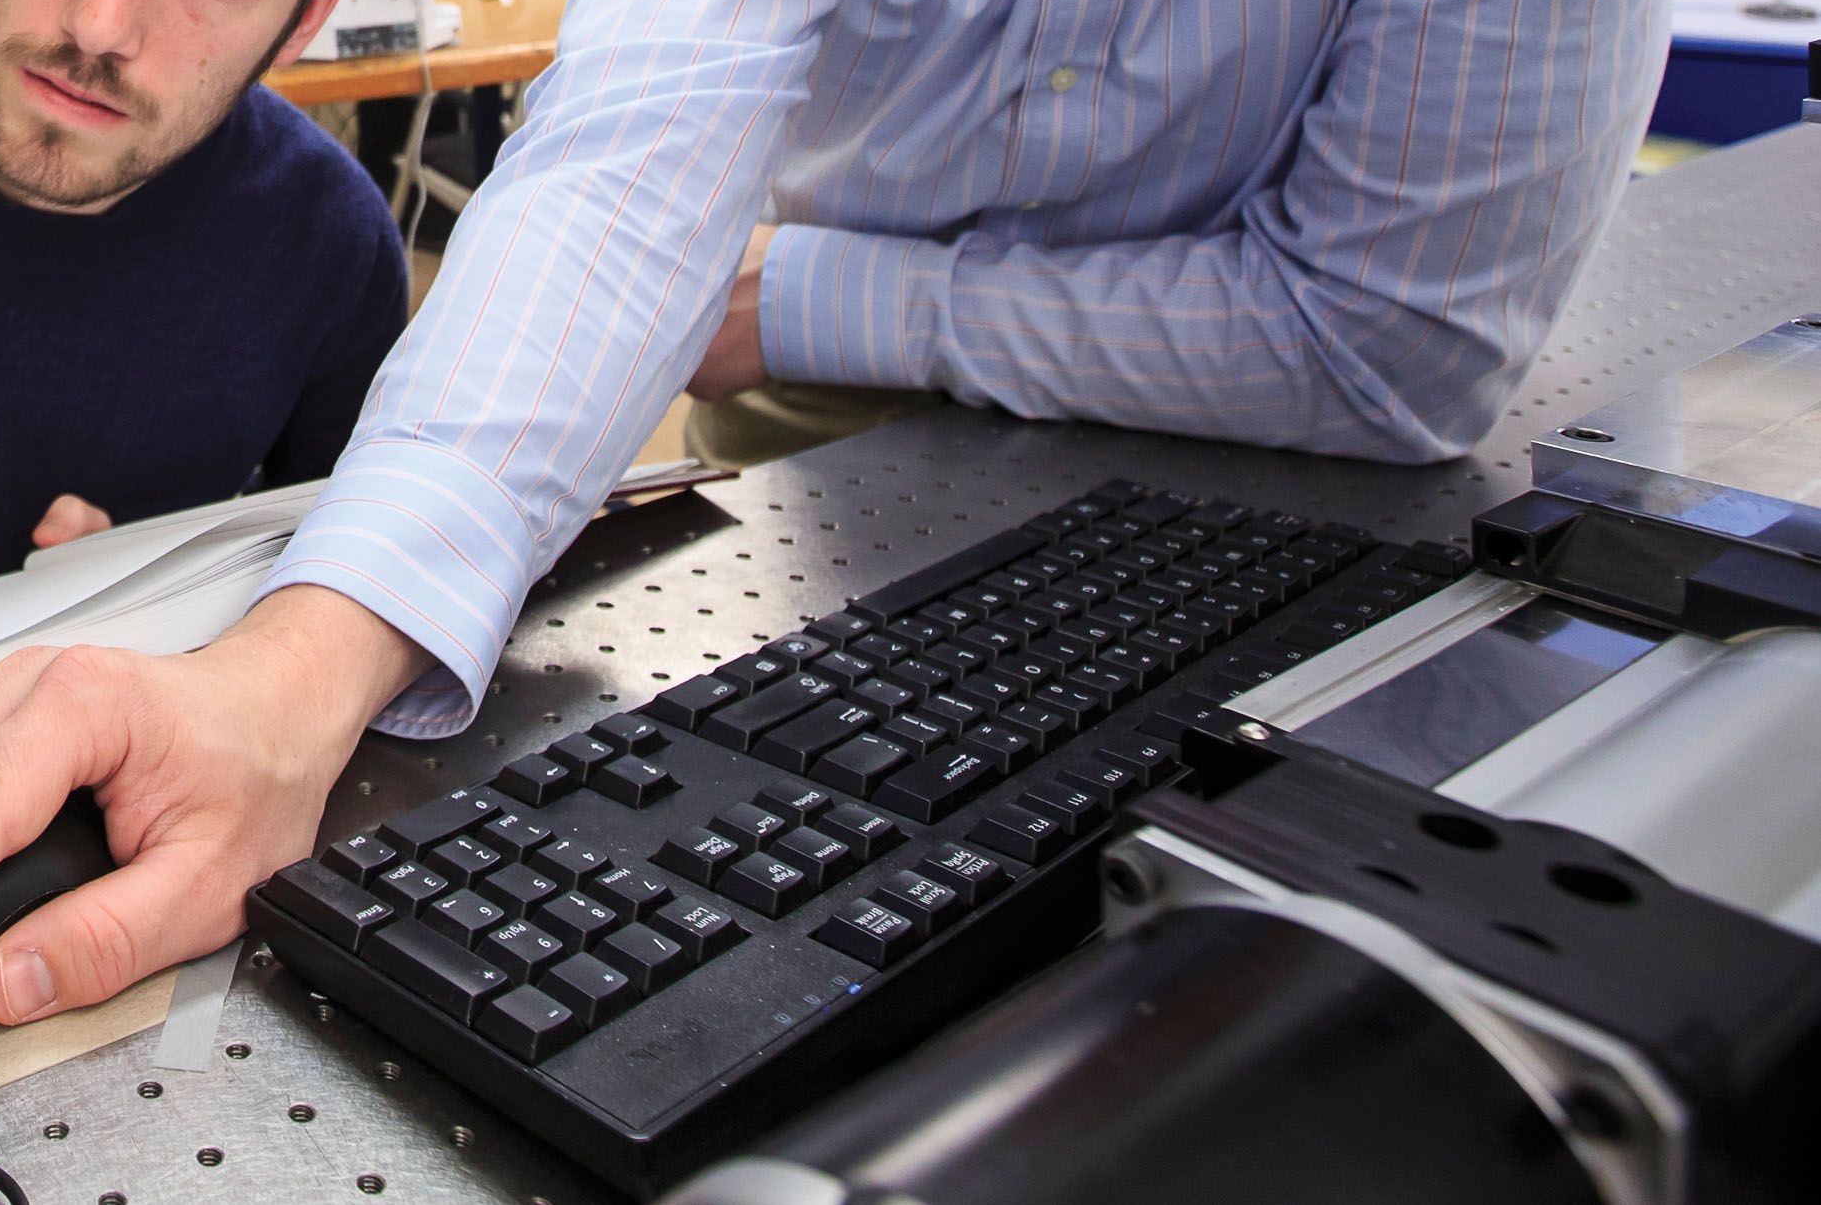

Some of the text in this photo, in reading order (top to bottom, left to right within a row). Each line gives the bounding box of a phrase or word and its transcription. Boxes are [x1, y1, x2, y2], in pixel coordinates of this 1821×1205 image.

[1142, 747, 1157, 757] F9
[943, 757, 980, 783] Backspace
[1103, 769, 1123, 782] F10
[451, 790, 467, 800] Ins
[792, 791, 820, 807] Delete
[1068, 794, 1088, 806] F11
[498, 815, 518, 828] End
[859, 817, 885, 832] Insert
[1028, 818, 1050, 833] F12
[528, 826, 539, 835] 1
[348, 836, 366, 848] Del
[693, 835, 722, 852] Down
[708, 842, 732, 856] Page
[476, 850, 490, 860] 2
[582, 852, 595, 862] 4
[814, 842, 842, 858] Home
[941, 850, 972, 867] SysRq
[388, 865, 415, 881] PgDn
[765, 863, 786, 874] Up
[962, 857, 990, 876] PrtScn
[423, 877, 437, 887] 3
[602, 868, 631, 885] Home
[771, 869, 796, 883] Page
[533, 879, 547, 889] 5
[643, 880, 657, 891] 7
[908, 880, 933, 897] Lock
[919, 886, 946, 905] Scroll
[355, 904, 384, 921] Enter
[591, 908, 606, 918] 8
[683, 906, 710, 922] Lock
[853, 907, 884, 925] Break
[694, 912, 720, 929] Num
[873, 916, 902, 934] Pause
[498, 923, 526, 940] PgUp
